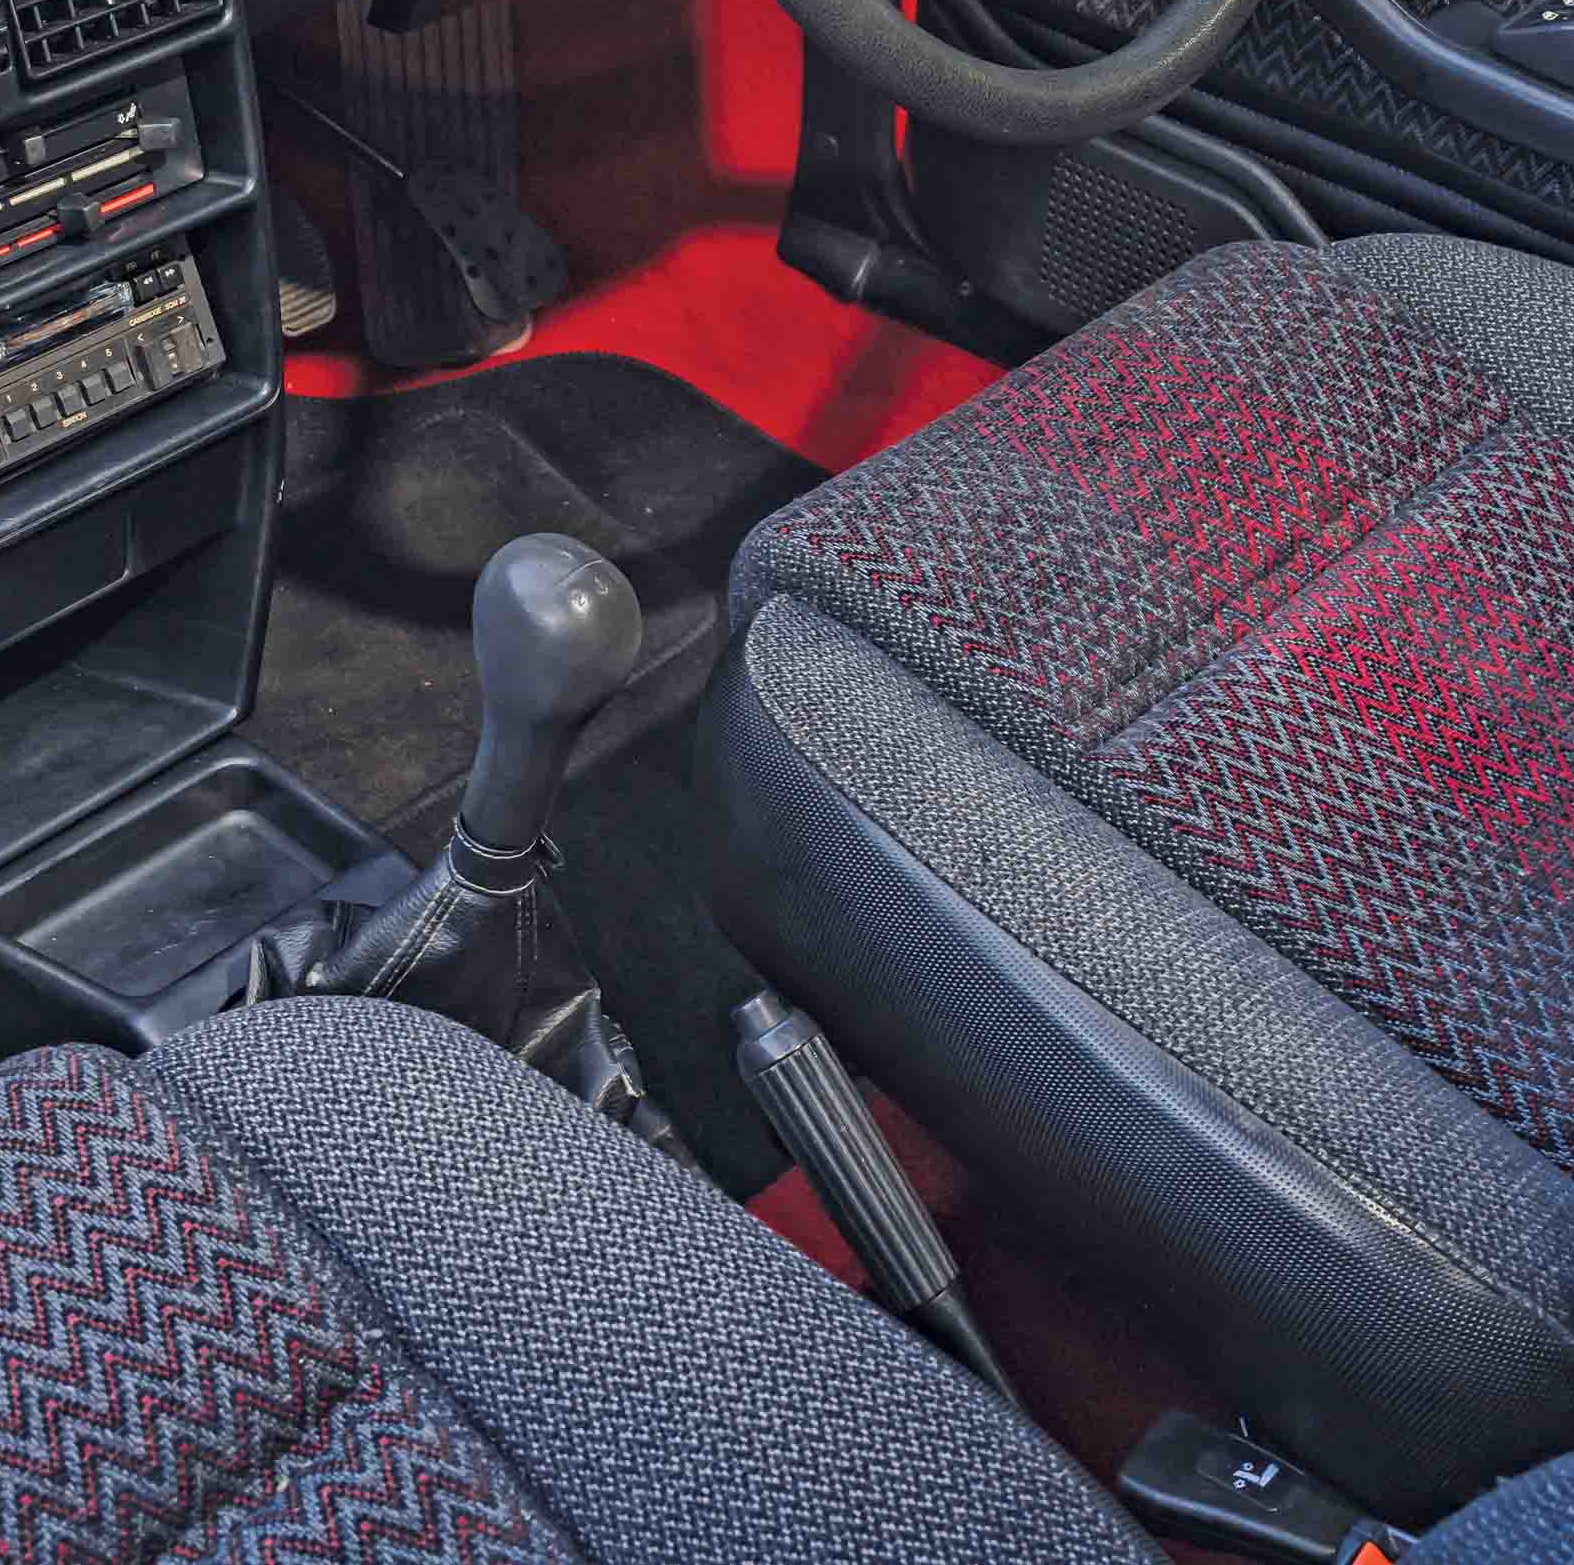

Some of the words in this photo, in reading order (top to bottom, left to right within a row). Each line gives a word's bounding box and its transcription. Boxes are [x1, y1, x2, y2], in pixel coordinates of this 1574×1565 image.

[106, 348, 113, 357] 5
[56, 371, 64, 380] 3
[31, 382, 39, 392] 2
